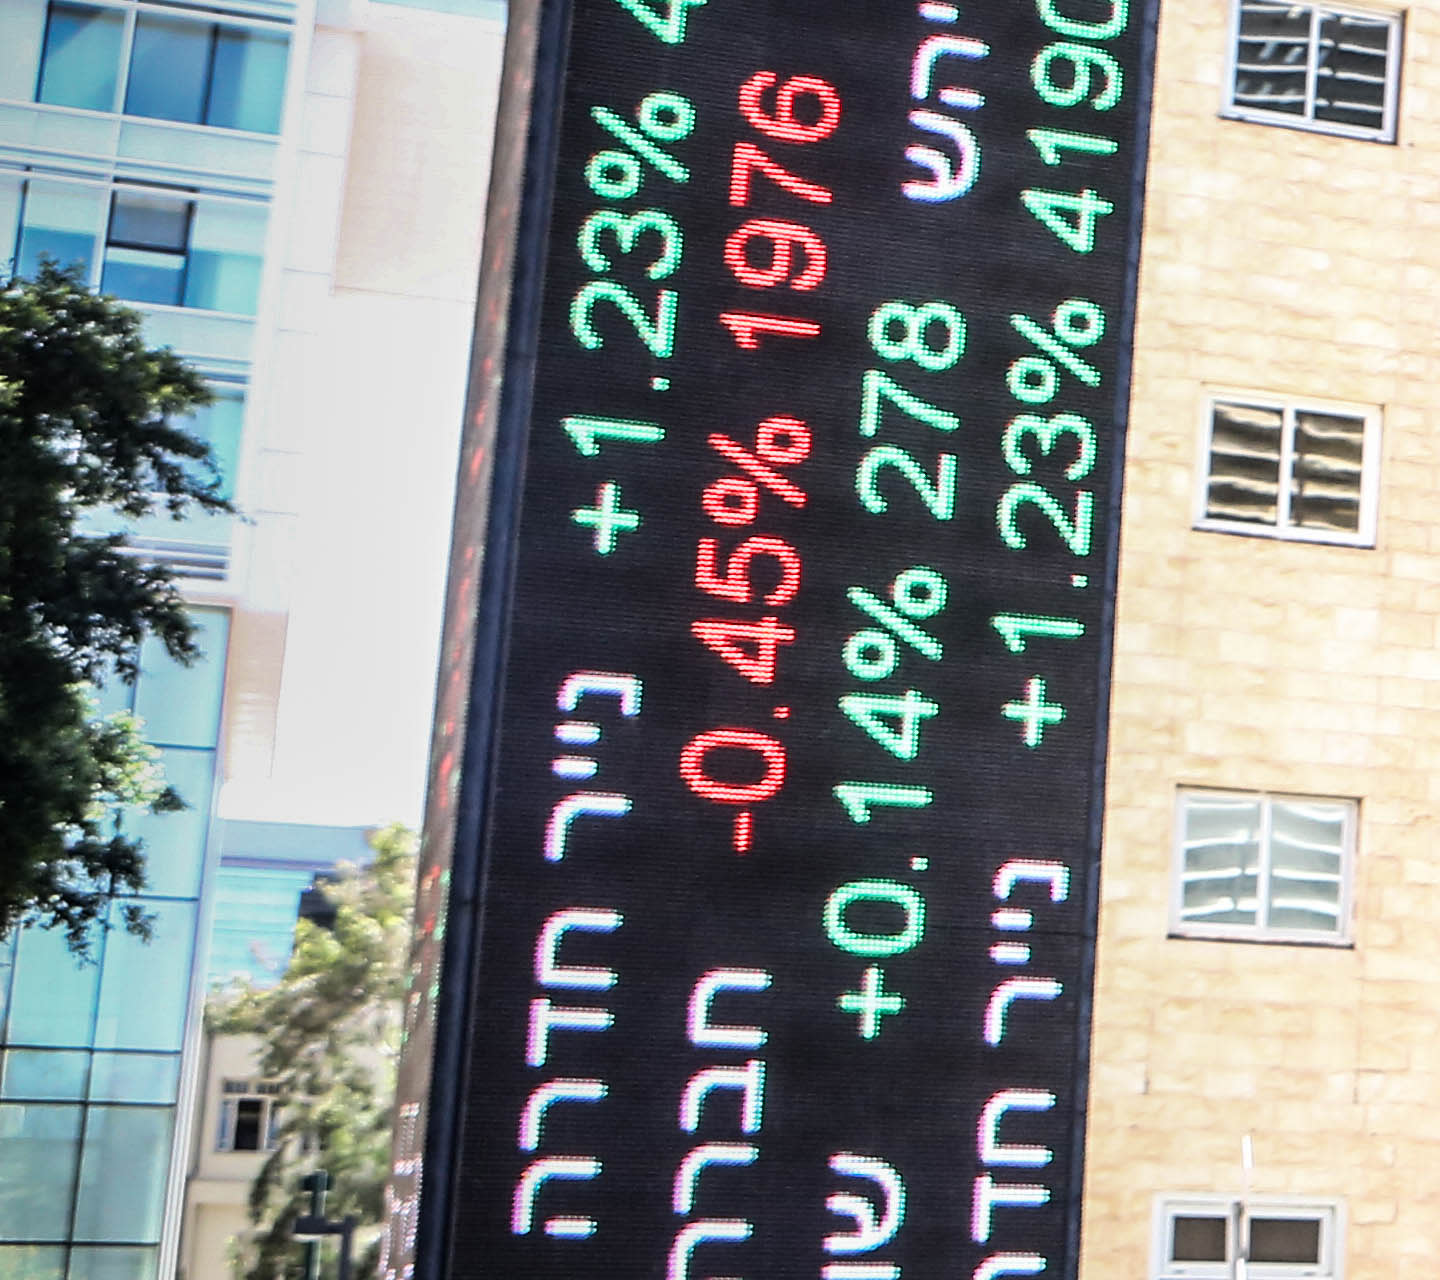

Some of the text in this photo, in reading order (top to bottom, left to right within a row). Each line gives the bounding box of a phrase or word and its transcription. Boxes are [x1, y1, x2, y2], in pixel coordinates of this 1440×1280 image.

[719, 71, 842, 350] 1976
[900, 0, 990, 207] יהש
[560, 90, 696, 557] +1.23%
[855, 298, 968, 520] 278
[679, 414, 813, 852] -0.45%
[990, 297, 1106, 749] +1.23%
[543, 670, 643, 864] נייר
[822, 566, 948, 1041] +0.14%
[511, 907, 624, 1240] חדרה
[982, 857, 1072, 1048] נייר
